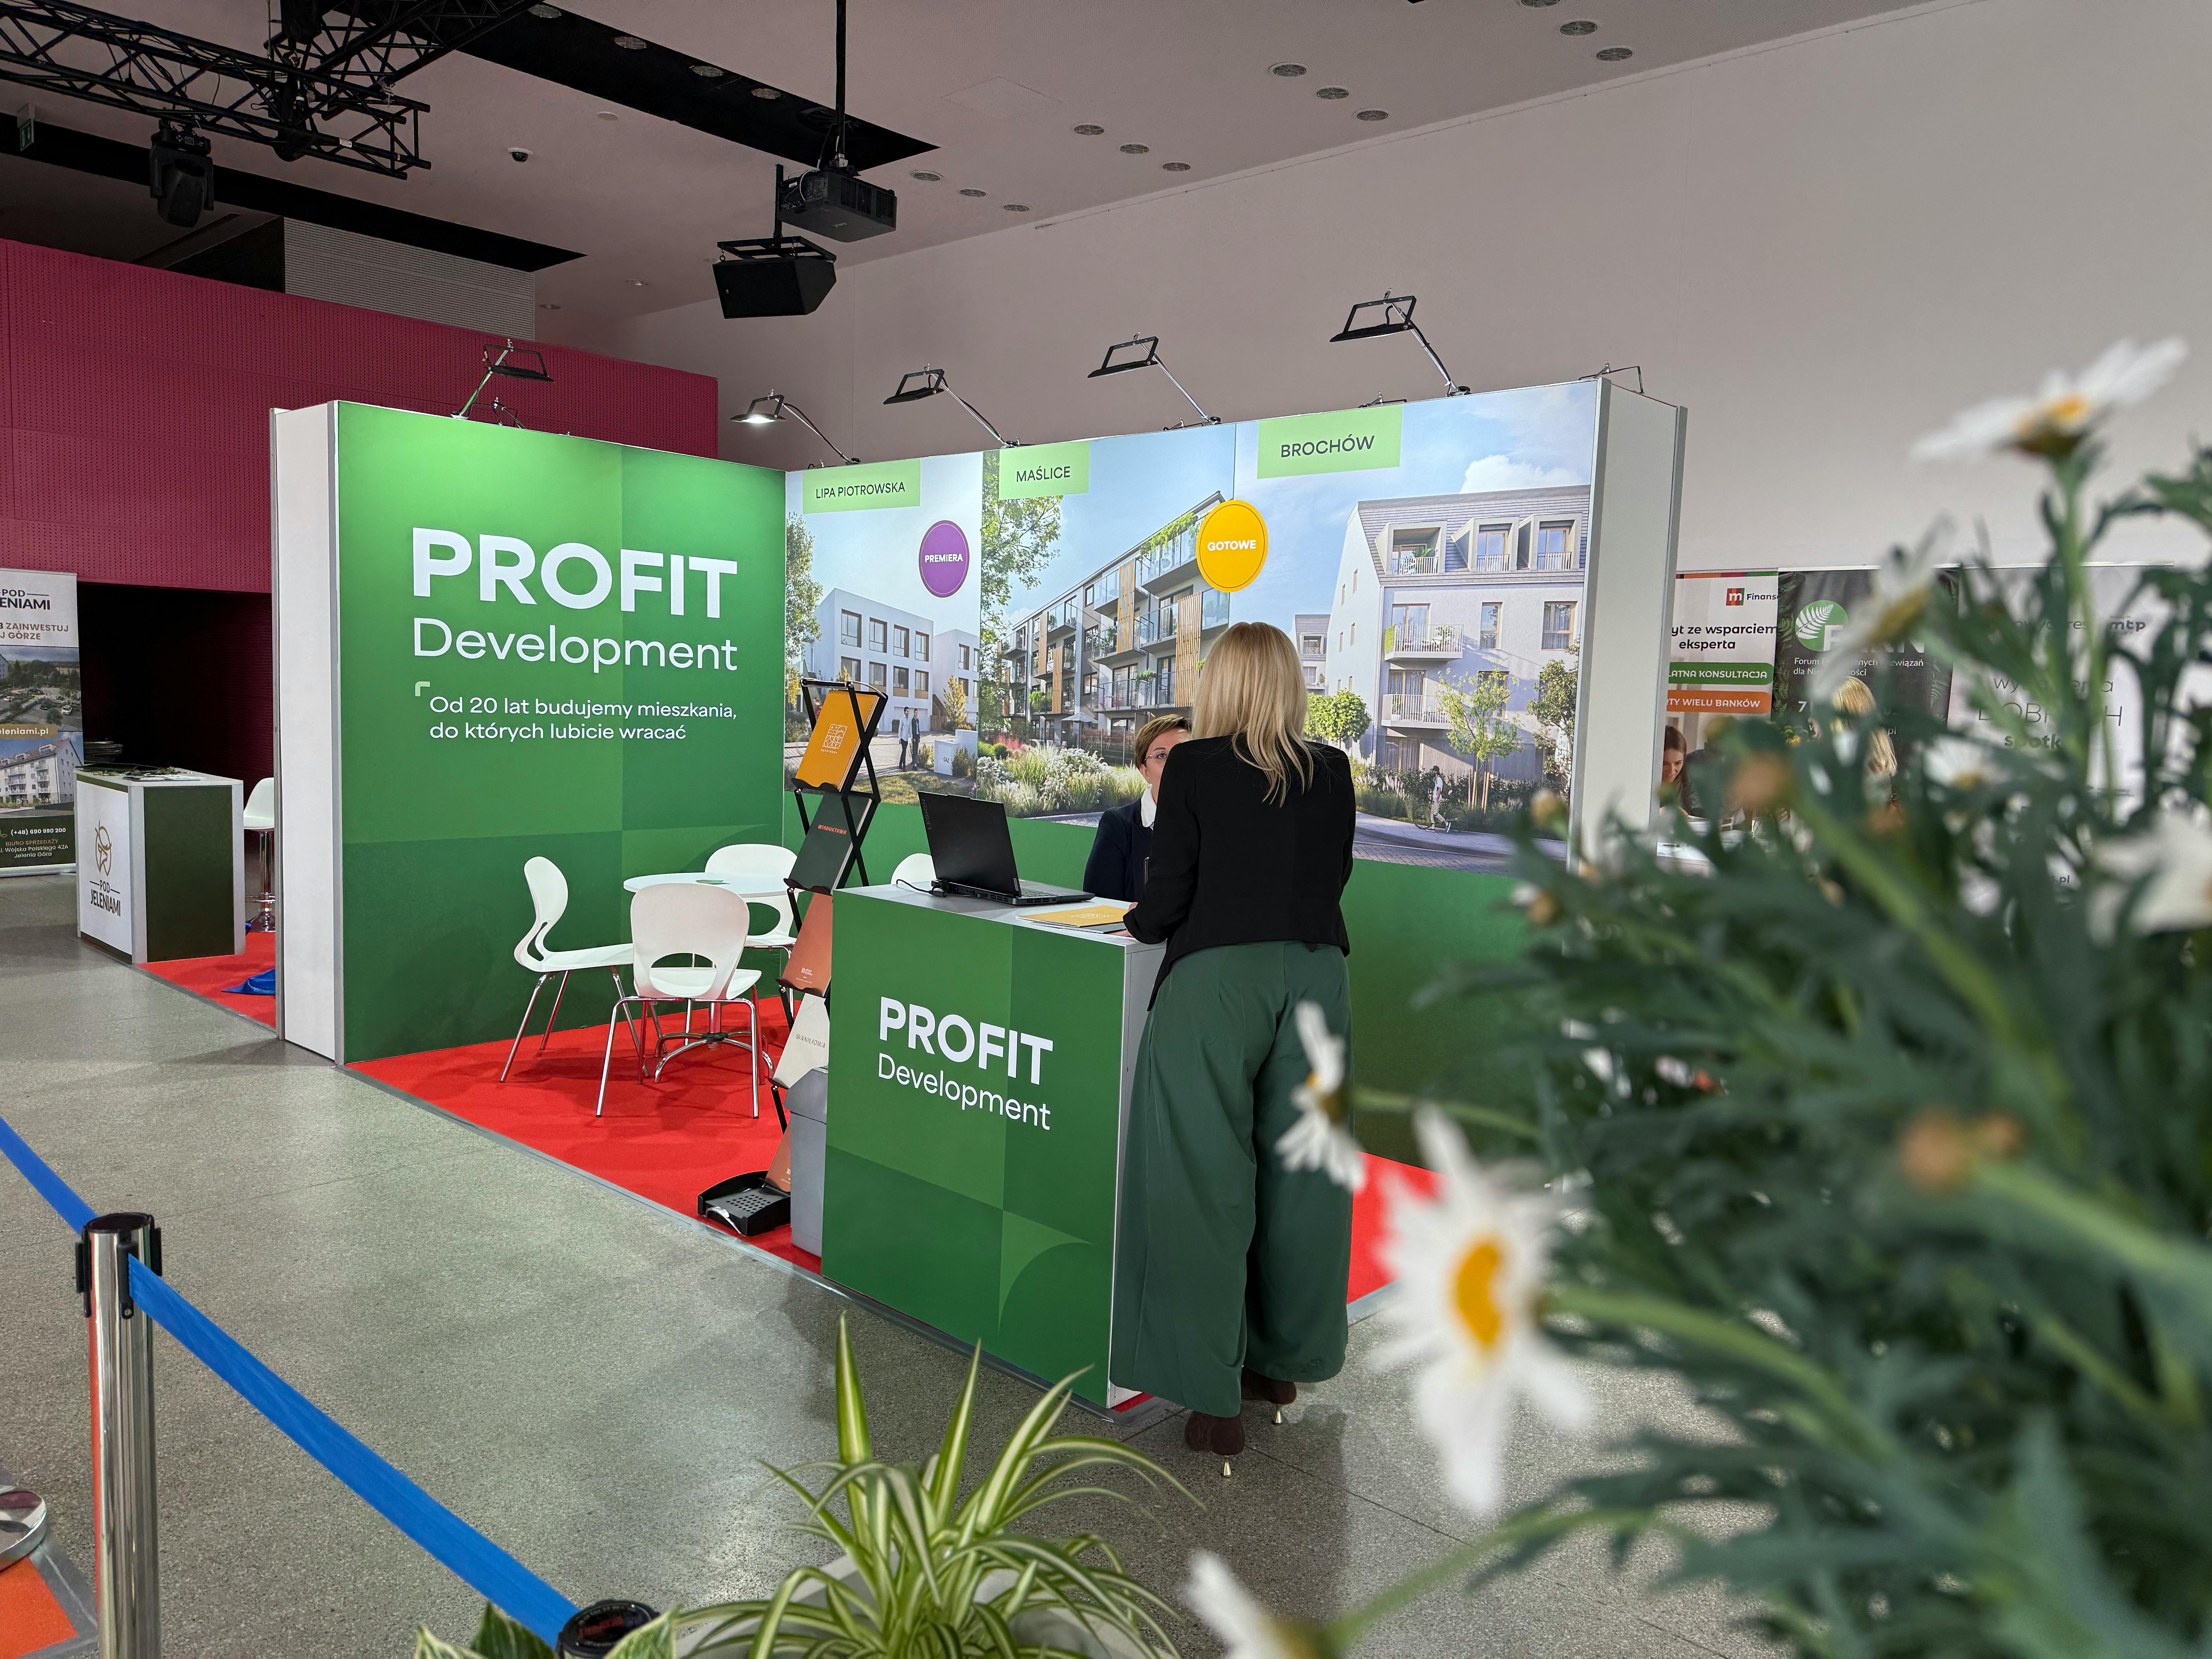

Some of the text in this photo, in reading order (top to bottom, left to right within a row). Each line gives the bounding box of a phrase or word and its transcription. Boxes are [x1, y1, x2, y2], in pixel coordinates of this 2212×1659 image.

[1281, 433, 1375, 458] BROCHÓW
[1017, 465, 1070, 483] MAŚLICE
[816, 481, 905, 499] LIPA PIOTROWSKA
[1207, 539, 1256, 551] GOTOWE
[924, 553, 963, 563] PREMIERA
[412, 527, 737, 618] PROFIT
[2, 589, 26, 597] POD
[6, 623, 69, 632] ZAINWESTUJ
[8, 630, 41, 640] GÓRZE
[414, 617, 738, 674] Development
[1679, 639, 1736, 651] eksperta
[1699, 670, 1767, 678] KONSULTACJA
[429, 696, 737, 721] Od 20 lat budujemy mieszkania,
[1716, 698, 1760, 708] BANKÓW
[429, 722, 687, 742] do których lubicie wracać
[818, 824, 847, 835] WIADUKTOWA
[100, 879, 110, 893] POD
[91, 889, 121, 917] JELENIAMI
[796, 1033, 826, 1049] WANILIOWA
[879, 996, 1053, 1085] PROFIT
[878, 1053, 1051, 1130] Development
